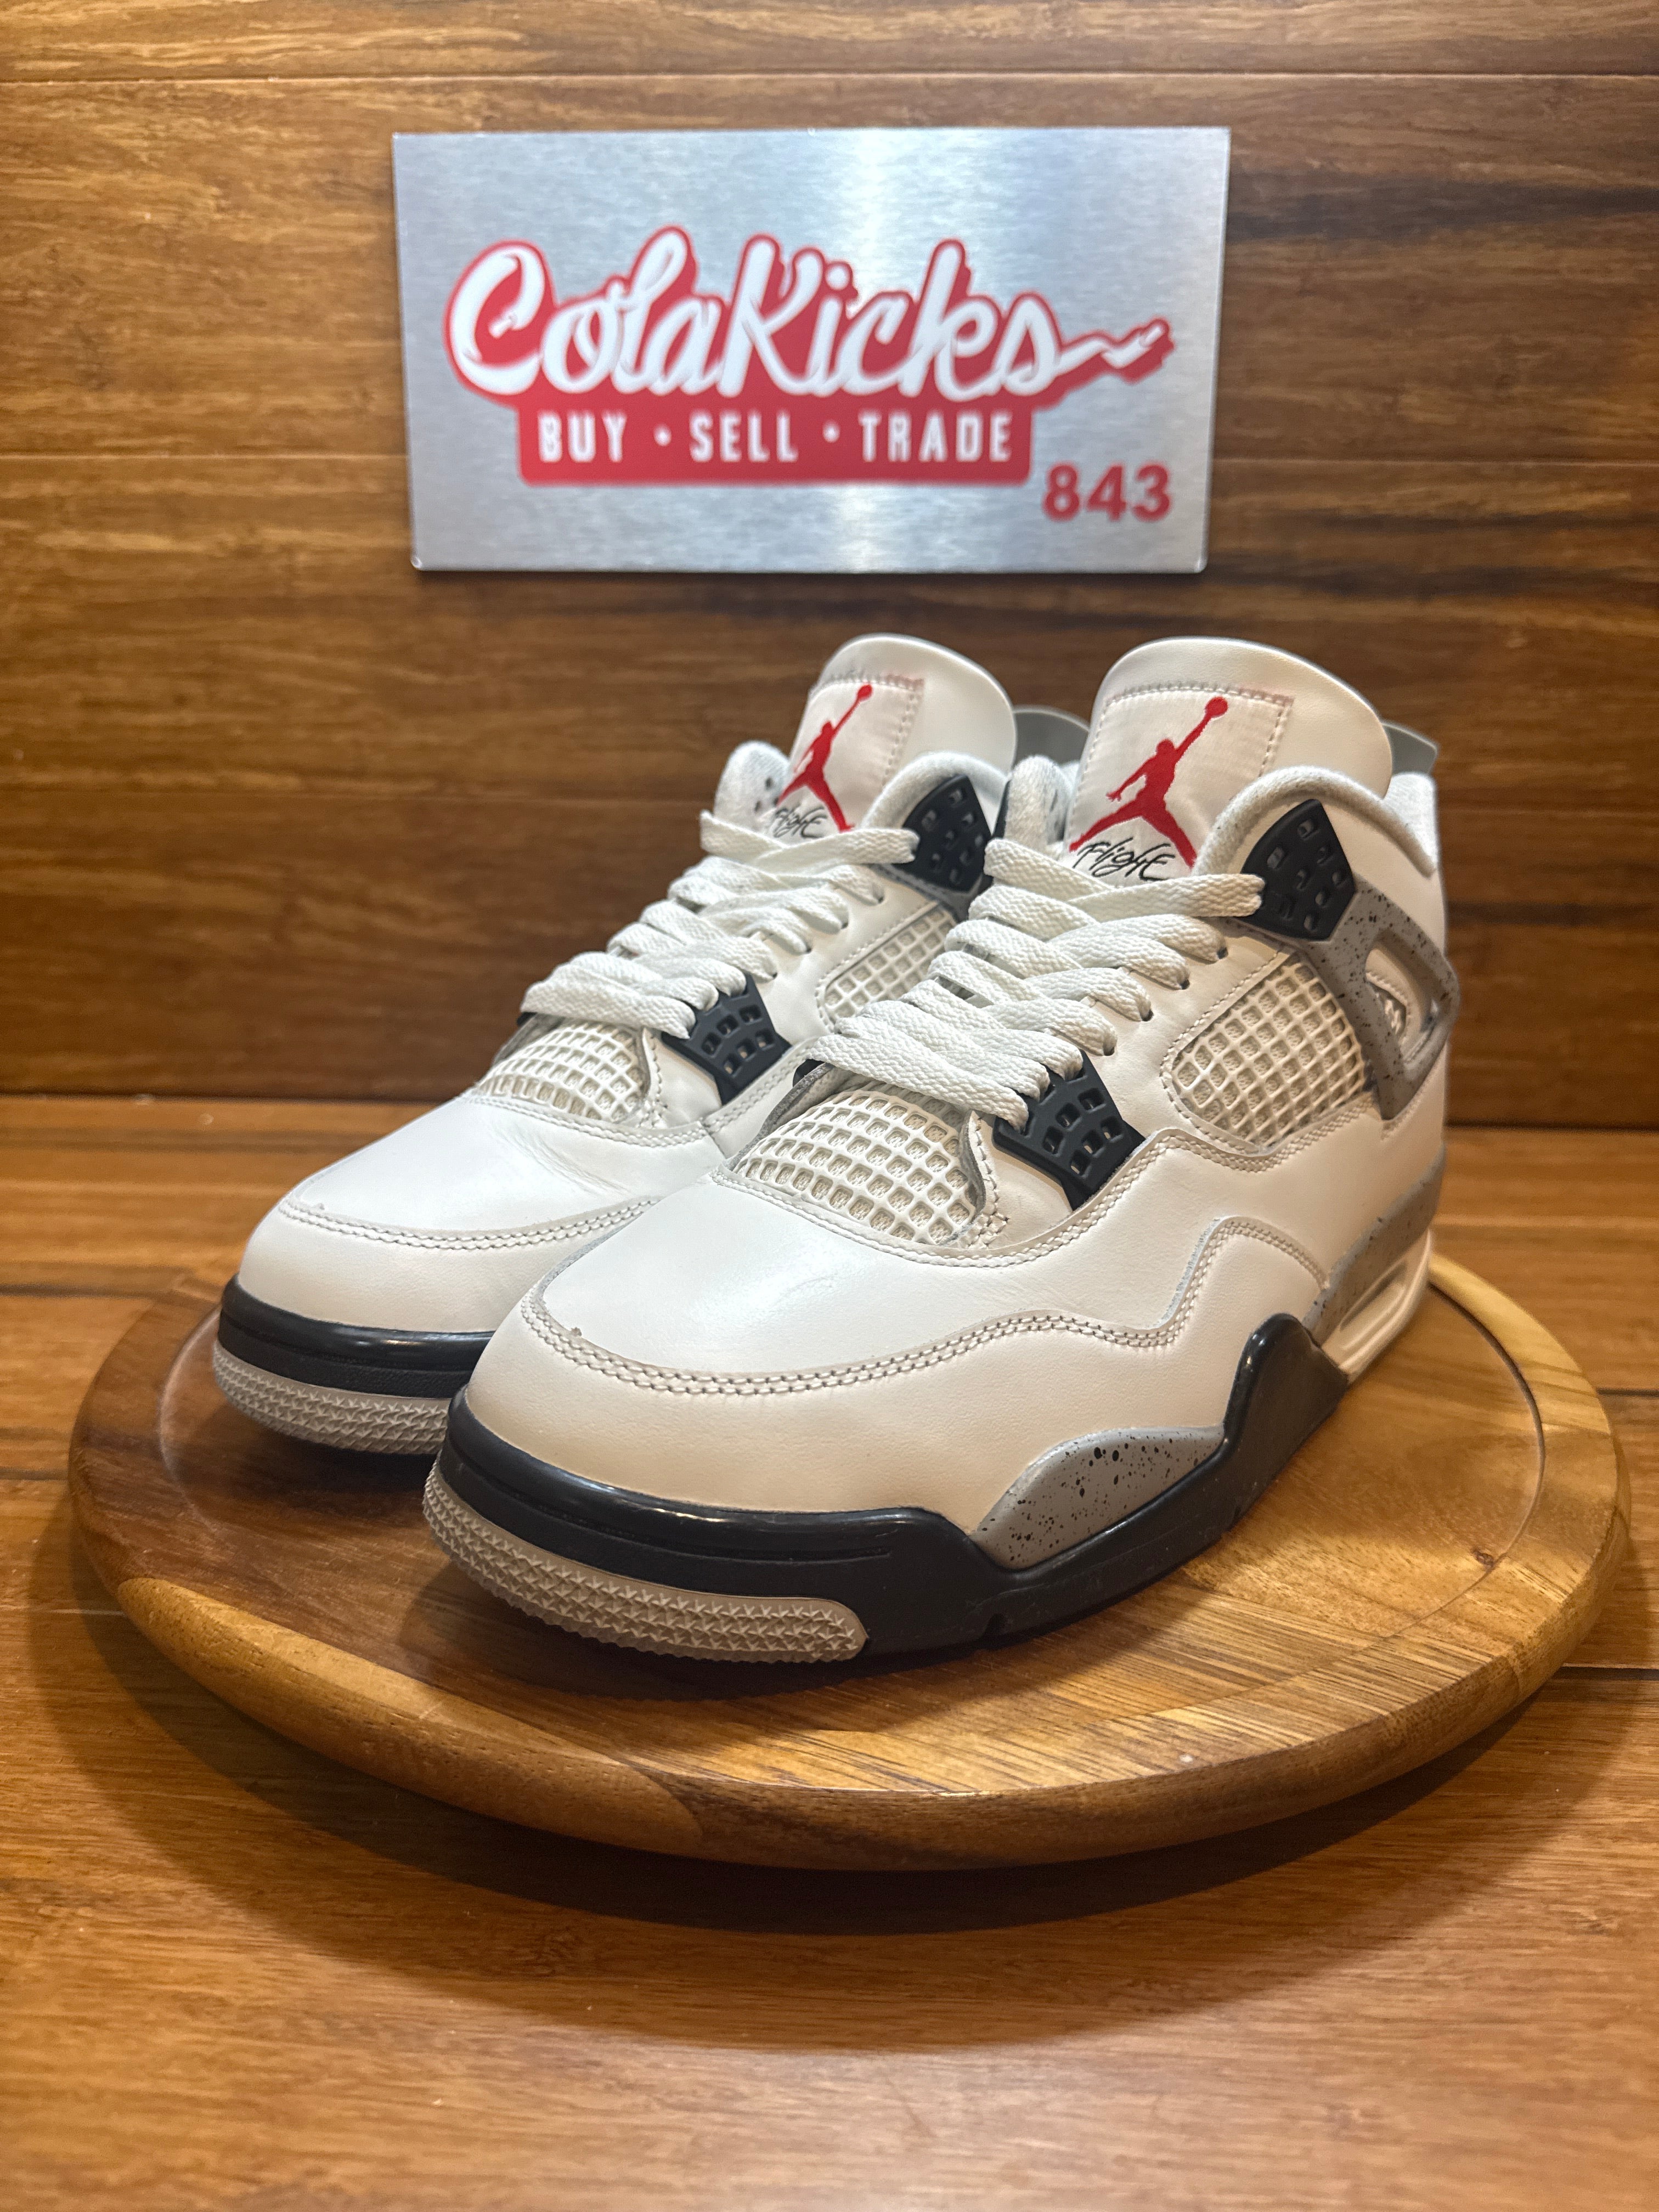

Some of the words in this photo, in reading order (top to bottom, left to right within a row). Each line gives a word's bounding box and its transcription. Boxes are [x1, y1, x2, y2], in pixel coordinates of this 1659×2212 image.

[448, 226, 1173, 403] ColaKicks
[537, 410, 627, 462] BUY
[689, 409, 798, 462] SELL
[858, 409, 1012, 462] TRADE
[1044, 461, 1171, 523] 843
